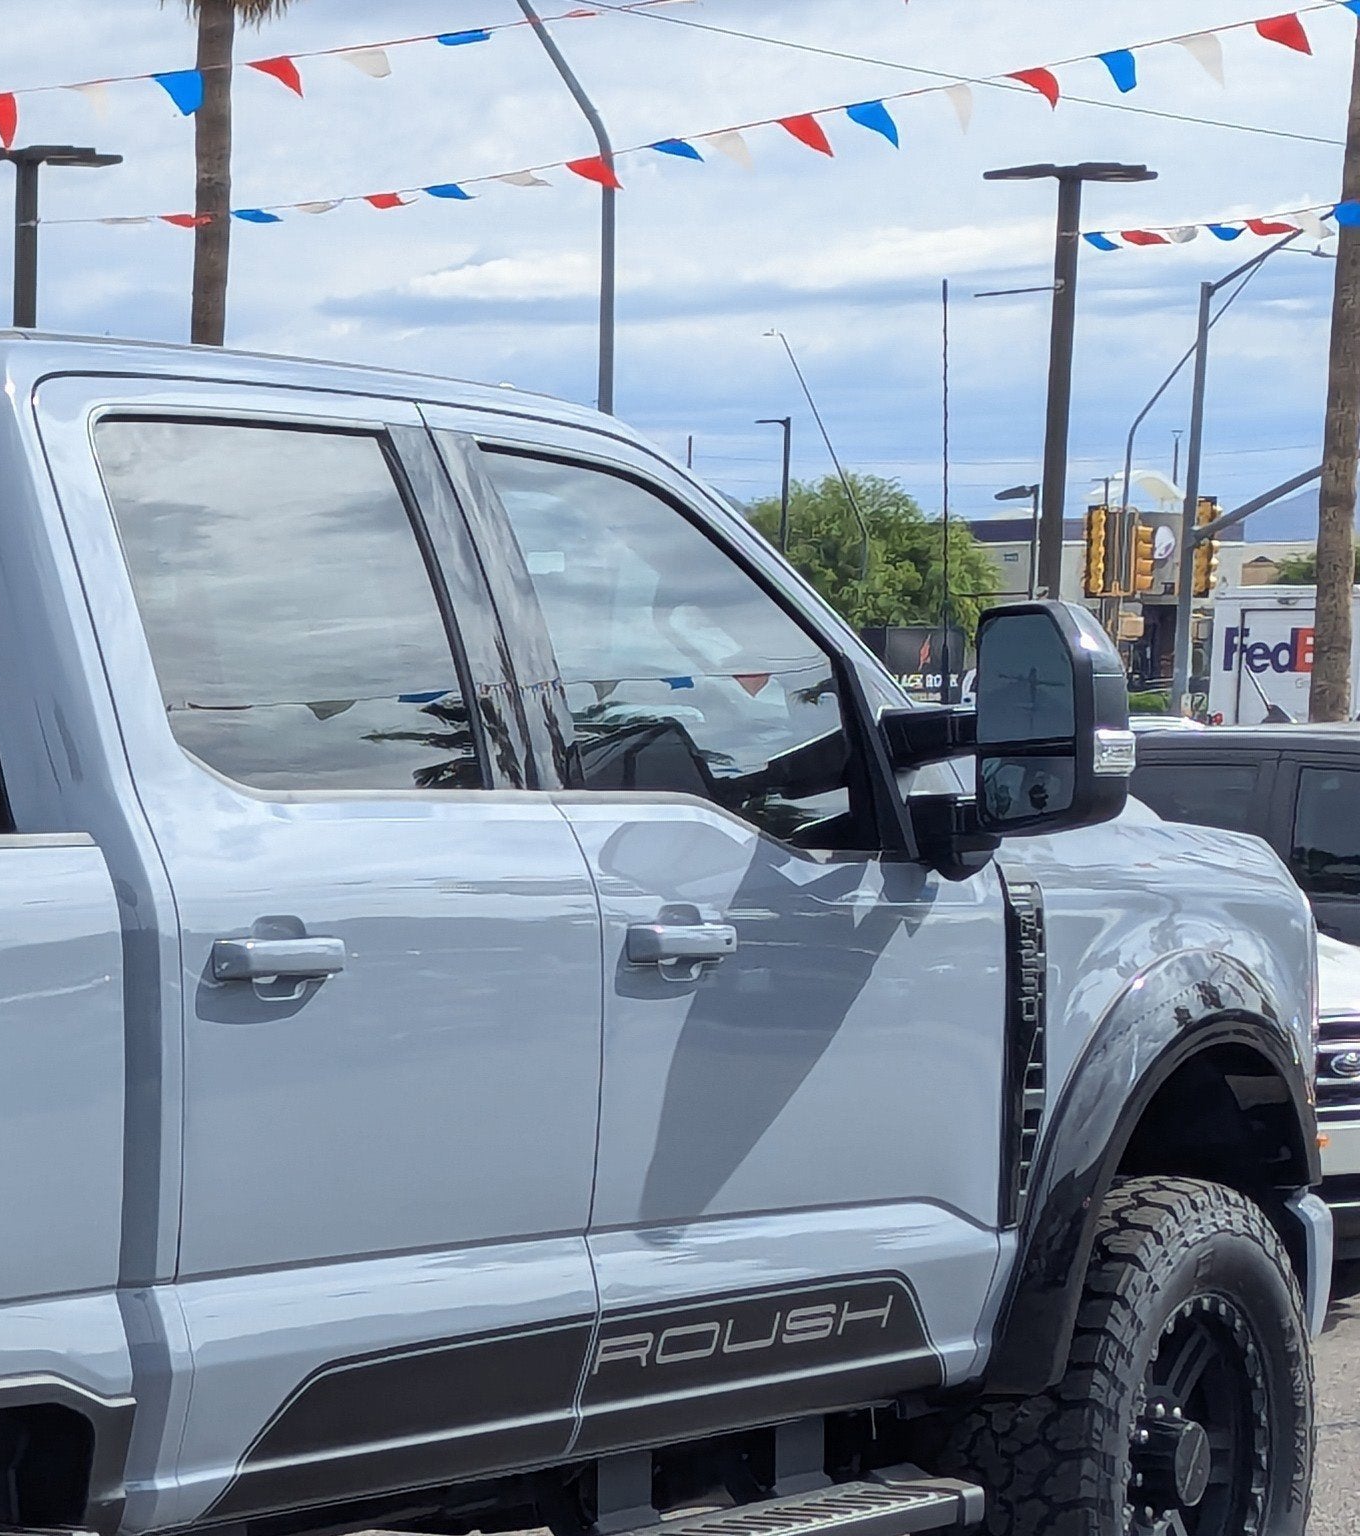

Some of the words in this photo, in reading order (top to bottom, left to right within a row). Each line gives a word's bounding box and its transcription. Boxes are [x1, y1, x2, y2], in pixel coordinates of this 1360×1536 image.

[1223, 627, 1315, 673] FedE
[925, 673, 959, 688] ROK
[591, 1295, 893, 1374] ROUSH
